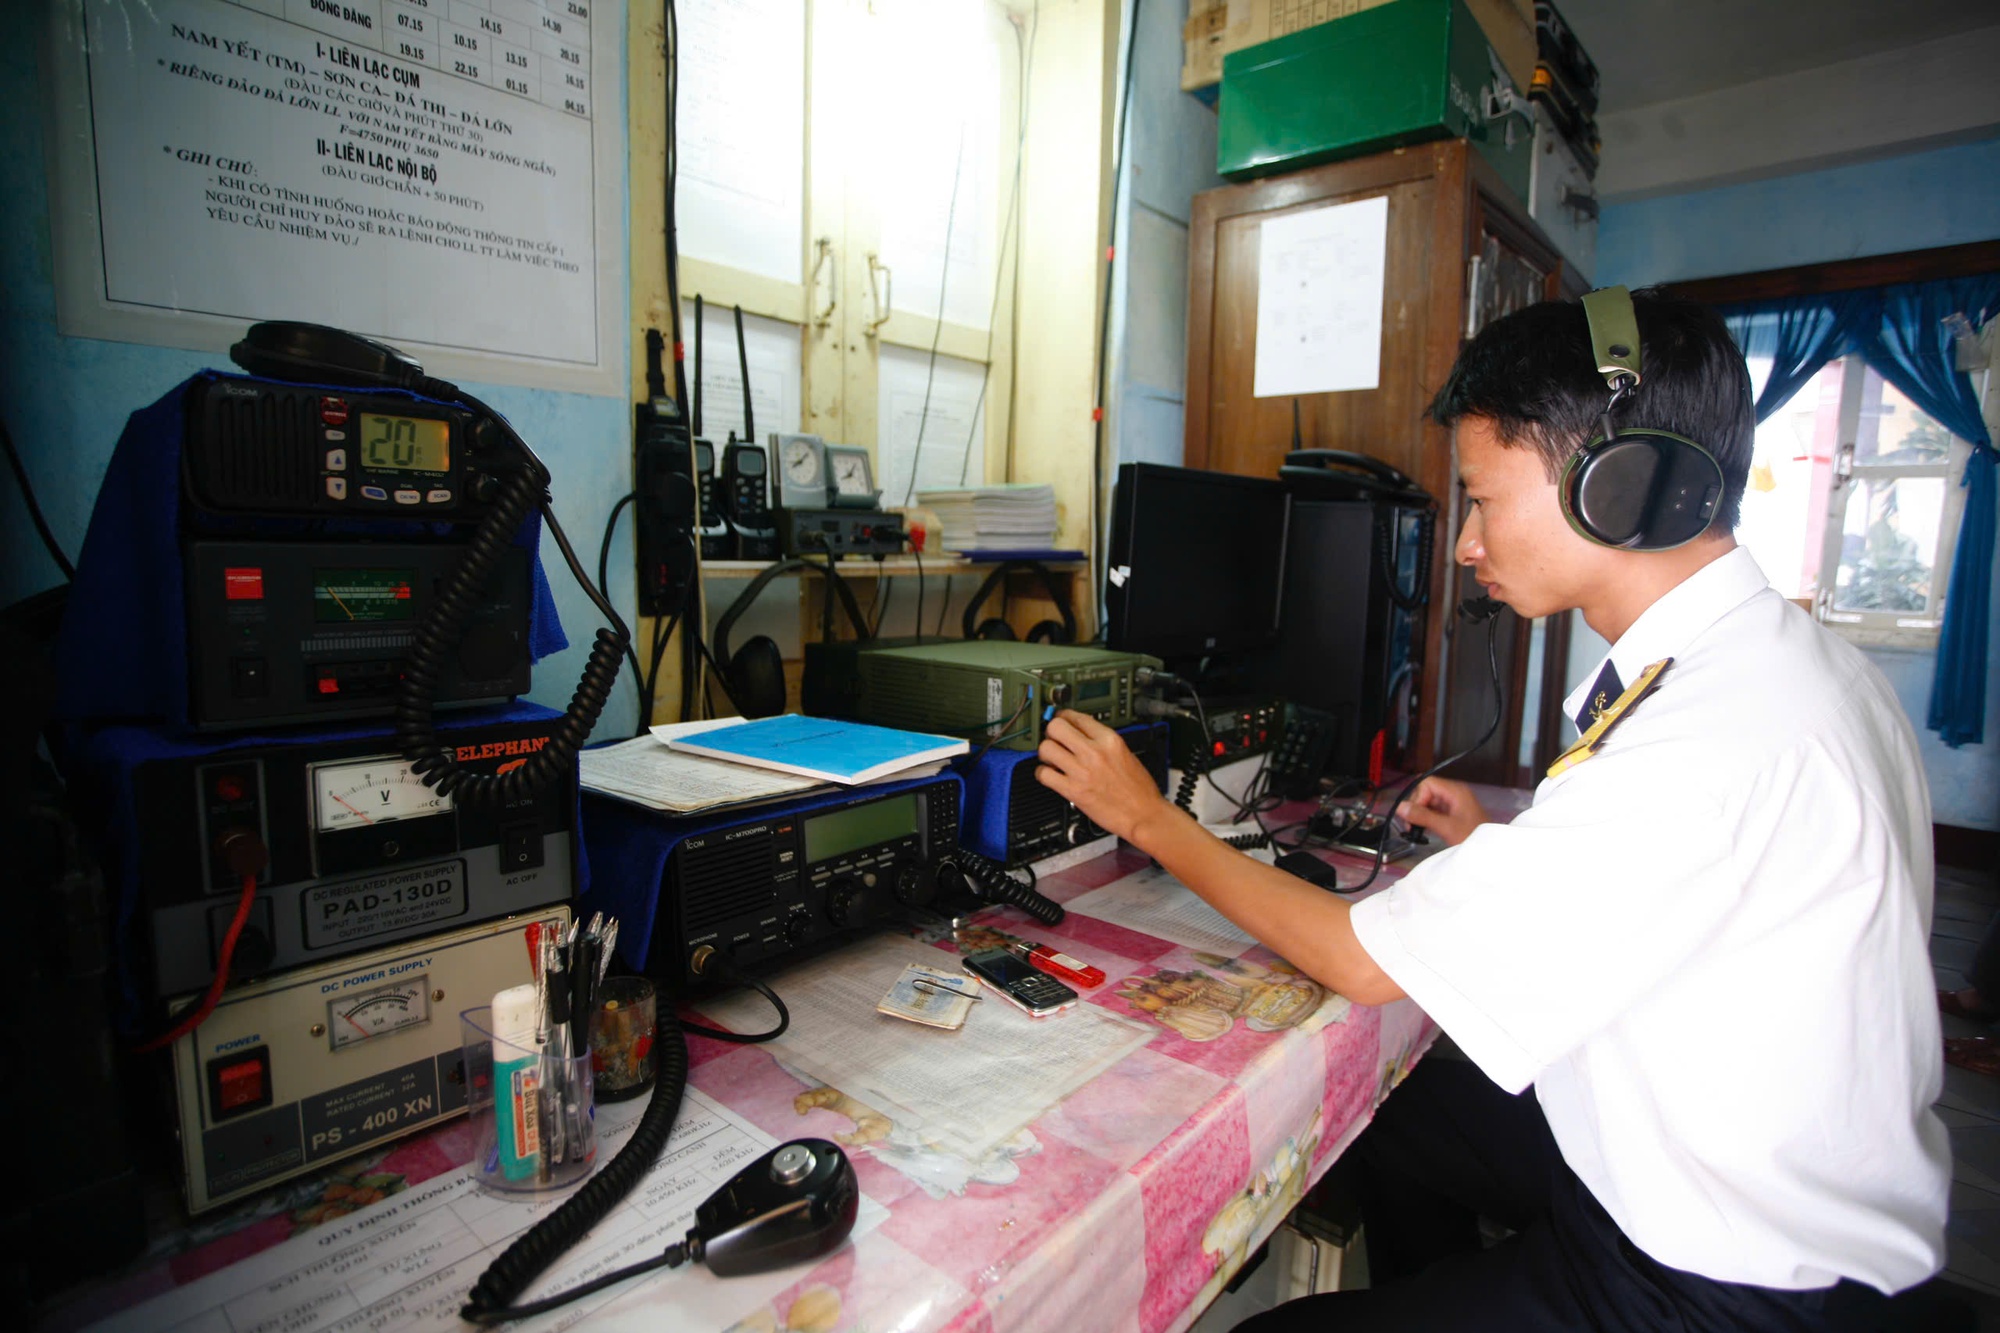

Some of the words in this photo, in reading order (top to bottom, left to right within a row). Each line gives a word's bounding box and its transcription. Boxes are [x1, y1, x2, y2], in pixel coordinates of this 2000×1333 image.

[397, 14, 424, 32] 07.15
[480, 17, 502, 35] 14.15
[542, 16, 562, 34] 14.30
[454, 33, 478, 51] 10.15
[399, 43, 425, 61] 19.15
[506, 52, 528, 68] 13.15
[560, 48, 580, 65] 20.15
[171, 24, 218, 50] NAM
[222, 41, 262, 62] YẾT
[266, 53, 306, 77] (TM)
[323, 70, 356, 89] SƠN
[395, 91, 417, 108] ĐÁ
[330, 46, 360, 71] LIÊN
[363, 57, 389, 80] LẠC
[392, 66, 420, 89] CỤM
[454, 61, 479, 79] 22.15
[169, 62, 224, 86] RIÊNG
[227, 77, 261, 96] ĐẢO
[264, 88, 285, 103] ĐÁ
[505, 78, 528, 95] 01.15
[325, 88, 356, 105] CÁC
[404, 109, 438, 129] PHÚT
[564, 99, 585, 116] 04.15
[176, 148, 212, 167] GHI
[413, 145, 440, 160] 3650
[334, 141, 365, 165] LIÊN
[397, 158, 418, 180] NỘI
[421, 163, 438, 186] BỘ
[434, 191, 448, 203] 50
[205, 189, 257, 211] NGƯỜI
[289, 207, 320, 224] HUY
[324, 212, 357, 231] ĐẢO
[377, 223, 397, 238] RA
[434, 234, 462, 250] CHO
[206, 206, 240, 225] YÊU
[218, 175, 246, 192] KHI
[249, 182, 271, 197] CÓ
[273, 186, 311, 205] TÌNH
[314, 194, 365, 217] HUỐNG
[408, 213, 435, 231] BÁO
[472, 227, 515, 247] THÔNG
[514, 236, 536, 252] TIN
[223, 383, 258, 397] ICOM
[368, 416, 416, 467] 20
[456, 737, 550, 762] ELEPHAN
[684, 838, 706, 850] ICOM
[725, 825, 767, 841] IC-M700PRO
[313, 891, 328, 901] DC
[329, 880, 388, 899] REGULATED
[388, 871, 422, 885] POWER
[423, 865, 457, 880] SUPPLY
[506, 877, 519, 886] AC
[520, 872, 538, 882] OFF
[322, 879, 453, 920] PAD-130D
[322, 920, 350, 932] INPUT
[338, 924, 375, 939] OUTPUT
[321, 982, 340, 994] DC
[343, 970, 386, 989] POWER
[389, 958, 433, 976] SUPPLY
[214, 1033, 261, 1054] POWER
[325, 1097, 345, 1109] MAX
[345, 1082, 386, 1102] CURRENT
[326, 1102, 356, 1119] RATED
[356, 1087, 395, 1108] CURRENT
[311, 1126, 343, 1152] PS
[362, 1106, 398, 1133] 400
[403, 1094, 433, 1118] XN
